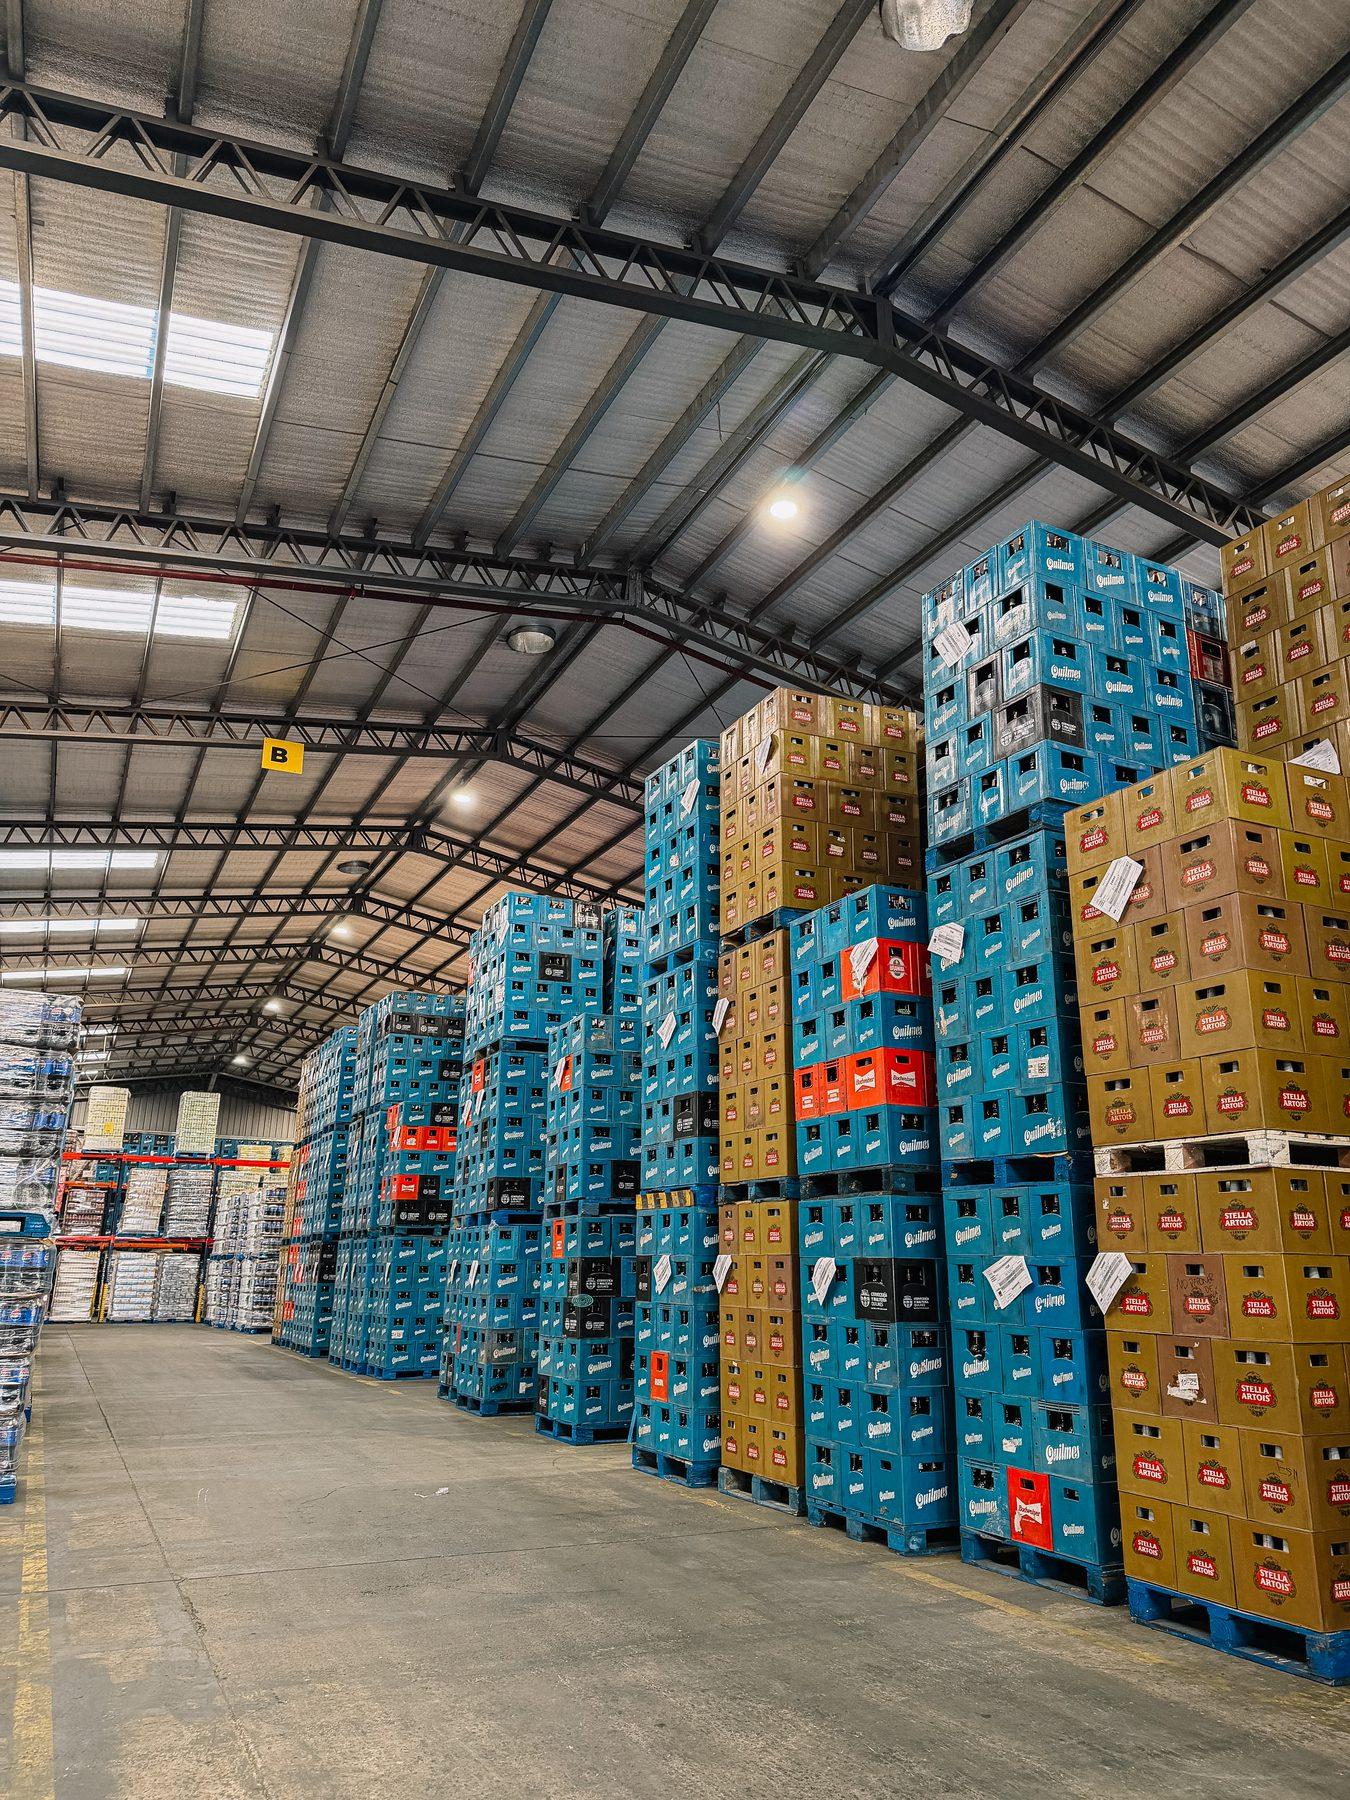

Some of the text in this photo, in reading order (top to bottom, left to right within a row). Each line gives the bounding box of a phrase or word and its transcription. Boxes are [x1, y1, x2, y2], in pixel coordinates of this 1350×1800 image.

[1047, 558, 1074, 571] Quilmes
[1097, 574, 1124, 587] Quilmes
[1303, 583, 1320, 594] STELLA
[1303, 587, 1320, 598] ARTOIS
[1148, 590, 1173, 602] Quilmes
[1048, 610, 1066, 620] Quilmes
[1246, 608, 1266, 622] STELLA
[1246, 614, 1266, 627] ARTOIS
[1086, 622, 1104, 631] Quilmes
[1126, 636, 1143, 644] Quilmes
[1163, 647, 1180, 655] Quilmes
[1051, 665, 1081, 679] Quilmes
[1106, 681, 1133, 694] Quilmes
[1156, 694, 1182, 708] Quilmes
[1256, 726, 1278, 739] ARTOIS
[1257, 720, 1276, 734] STELLA
[1096, 732, 1114, 741] Quilmes
[1134, 742, 1152, 751] Quilmes
[271, 746, 288, 762] B
[1060, 778, 1089, 792] Quilmes
[1246, 788, 1267, 798] STELLA
[1191, 794, 1210, 805] STELLA
[1191, 799, 1210, 809] ARTOIS
[1247, 794, 1268, 804] ARTOIS
[1310, 803, 1330, 811] STELLA
[1311, 808, 1331, 818] ARTOIS
[1084, 833, 1103, 844] STELLA
[1084, 839, 1103, 849] ARTOIS
[1186, 863, 1210, 877] STELLA
[1249, 860, 1267, 869] STELLA
[1249, 865, 1268, 875] ARTOIS
[1006, 866, 1034, 893] Quilmes
[1187, 869, 1211, 882] ARTOIS
[970, 887, 986, 902] Quilmes
[937, 901, 952, 916] Quilmes
[888, 917, 916, 929] Quilmes
[1022, 929, 1040, 949] Quilmes
[1204, 938, 1226, 948] STELLA
[1264, 935, 1285, 944] STELLA
[985, 942, 1002, 958] Quilmes
[1204, 943, 1227, 954] ARTOIS
[1265, 940, 1287, 950] ARTOIS
[1154, 955, 1174, 964] STELLA
[1154, 959, 1175, 970] ARTOIS
[1097, 966, 1117, 975] STELLA
[1097, 972, 1117, 982] ARTOIS
[1014, 990, 1042, 1013] Quilmes
[976, 1003, 993, 1018] Quilmes
[1202, 1015, 1225, 1025] STELLA
[1203, 1020, 1226, 1031] ARTOIS
[1268, 1019, 1286, 1028] ARTOIS
[893, 1025, 922, 1039] Quilmes
[1143, 1030, 1163, 1038] STELLA
[1144, 1034, 1163, 1043] ARTOIS
[947, 1065, 971, 1087] Quilmes
[992, 1063, 1009, 1078] Quilmes
[1221, 1096, 1242, 1104] STELLA
[1222, 1101, 1244, 1109] ARTOIS
[1284, 1100, 1307, 1108] ARTOIS
[1109, 1106, 1132, 1116] STELLA
[1109, 1113, 1132, 1122] ARTOIS
[949, 1132, 964, 1147] Quilmes
[983, 1127, 1000, 1142] Quilmes
[900, 1139, 929, 1154] Quilmes
[804, 1146, 822, 1164] Quilmes
[1224, 1212, 1252, 1220] STELLA
[956, 1225, 981, 1245] Quilmes
[1002, 1227, 1020, 1242] Quilmes
[1042, 1224, 1061, 1240] Quilmes
[805, 1230, 823, 1247] Quilmes
[905, 1228, 936, 1248] Quilmes
[958, 1297, 975, 1309] Quilmes
[1035, 1294, 1065, 1313] Quilmes
[1125, 1297, 1147, 1305] STELLA
[1312, 1300, 1334, 1308] STELLA
[810, 1349, 829, 1365] Quilmes
[910, 1358, 941, 1378] Quilmes
[964, 1360, 989, 1378] Quilmes
[1013, 1368, 1031, 1380] Quilmes
[1053, 1372, 1073, 1386] Quilmes
[1124, 1372, 1144, 1381] STELLA
[1125, 1378, 1145, 1387] ARTOIS
[1240, 1385, 1269, 1394] STELLA
[1313, 1390, 1333, 1398] STELLA
[1241, 1392, 1271, 1402] ARTOIS
[868, 1421, 891, 1438] Quilmes
[912, 1426, 933, 1441] Quilmes
[965, 1433, 982, 1445] Quilmes
[1046, 1444, 1079, 1464] Quilmes
[1138, 1462, 1160, 1472] STELLA
[1139, 1469, 1162, 1479] ARTOIS
[1203, 1469, 1224, 1478] STELLA
[813, 1474, 833, 1489] Quilmes
[1203, 1475, 1225, 1485] ARTOIS
[1263, 1484, 1287, 1494] STELLA
[879, 1490, 894, 1502] Quilmes
[916, 1486, 948, 1509] Quilmes
[1263, 1491, 1288, 1501] ARTOIS
[969, 1500, 997, 1516] Quilmes
[1063, 1524, 1084, 1536] Quilmes
[1138, 1540, 1157, 1549] STELLA
[1138, 1546, 1158, 1556] ARTOIS
[1192, 1559, 1213, 1569] STELLA
[1193, 1565, 1214, 1576] ARTOIS
[1260, 1569, 1288, 1583] STELLA
[1261, 1578, 1289, 1591] ARTOIS
